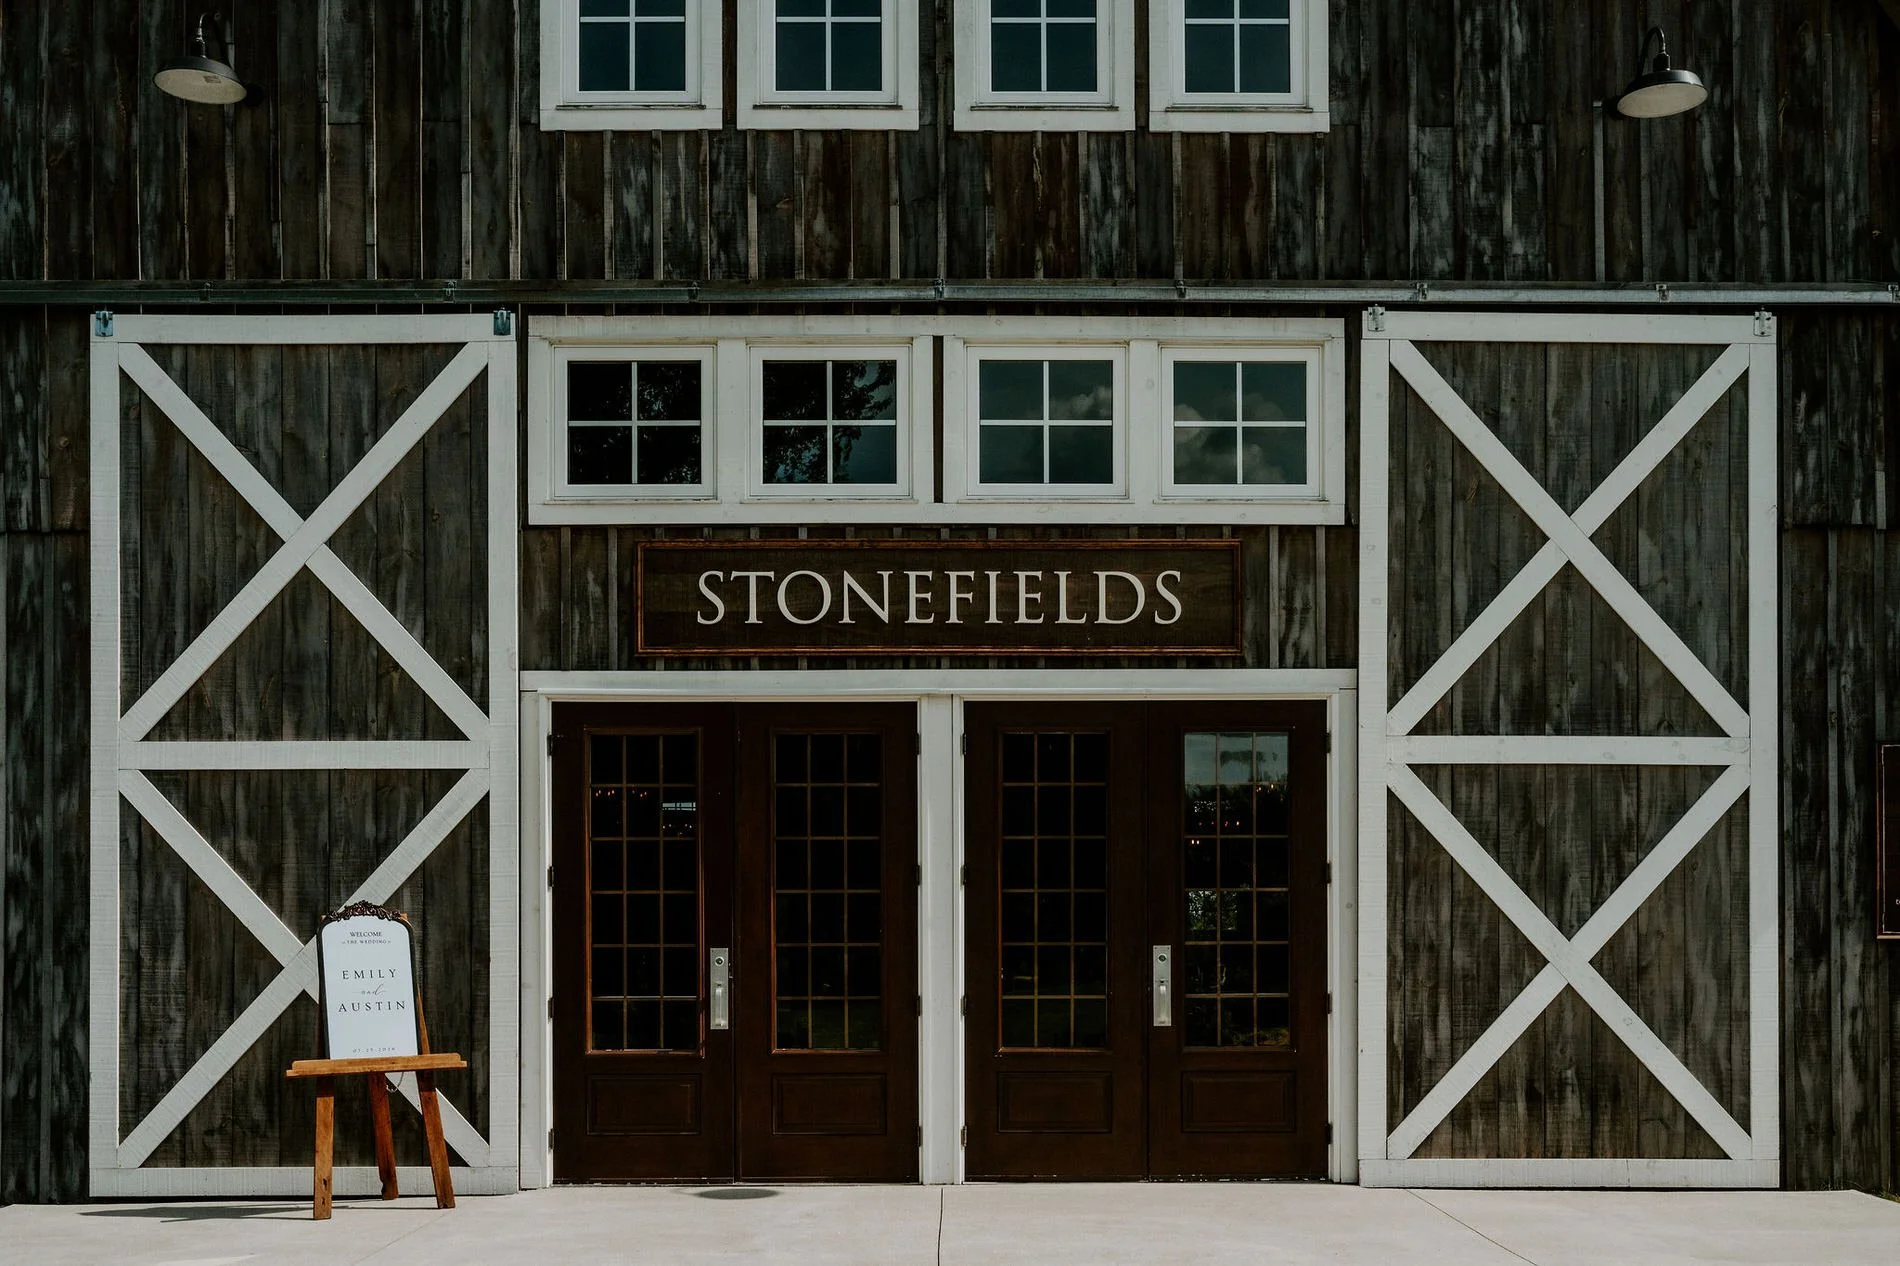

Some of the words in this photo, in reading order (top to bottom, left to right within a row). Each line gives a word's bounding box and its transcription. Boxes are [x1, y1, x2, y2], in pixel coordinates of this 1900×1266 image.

[696, 570, 1182, 625] STONEFIELDS
[341, 968, 397, 981] EMILY
[359, 983, 386, 996] and
[338, 1000, 406, 1013] AUSTIN
